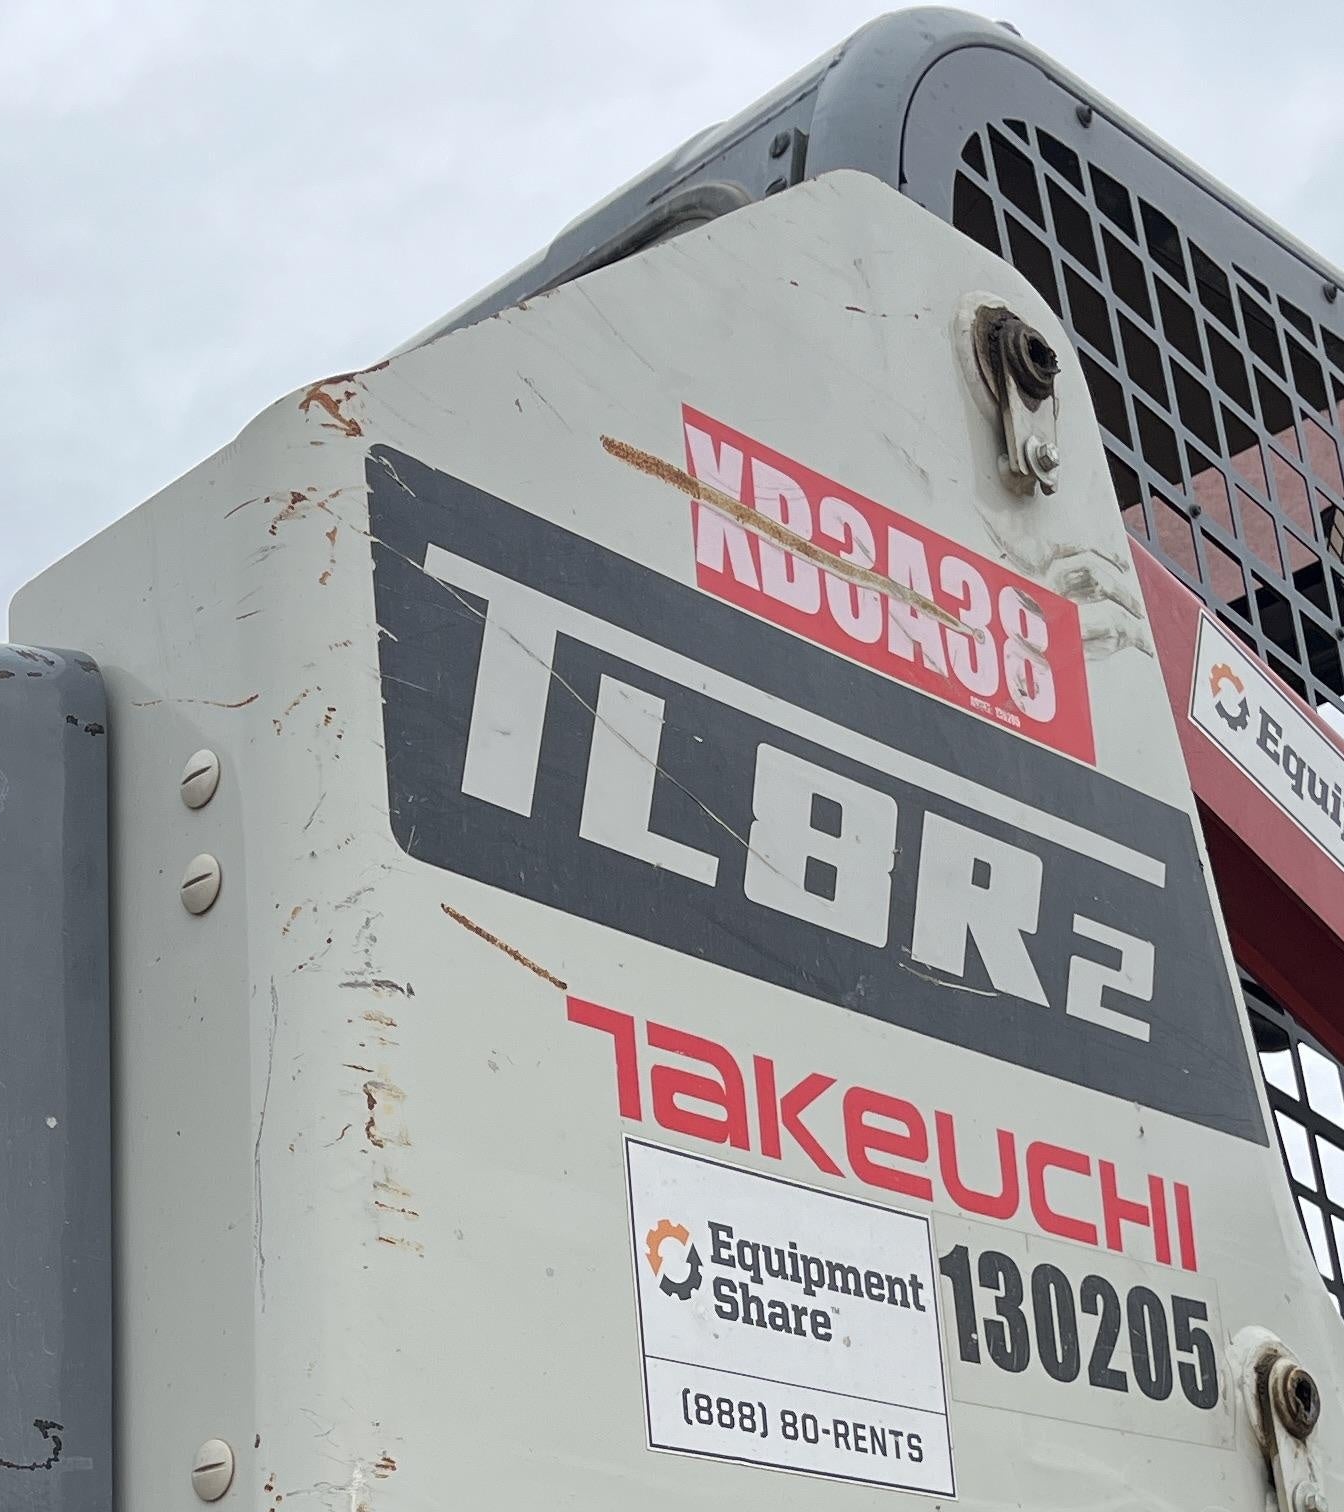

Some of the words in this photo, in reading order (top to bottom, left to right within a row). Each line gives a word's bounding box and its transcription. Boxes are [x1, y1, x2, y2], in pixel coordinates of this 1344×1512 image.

[707, 1221, 926, 1312] Equipment
[712, 1279, 833, 1342] Share
[939, 1244, 1220, 1410] 130205
[681, 1387, 768, 1438] (888)
[781, 1409, 923, 1463] 80-RENTS
